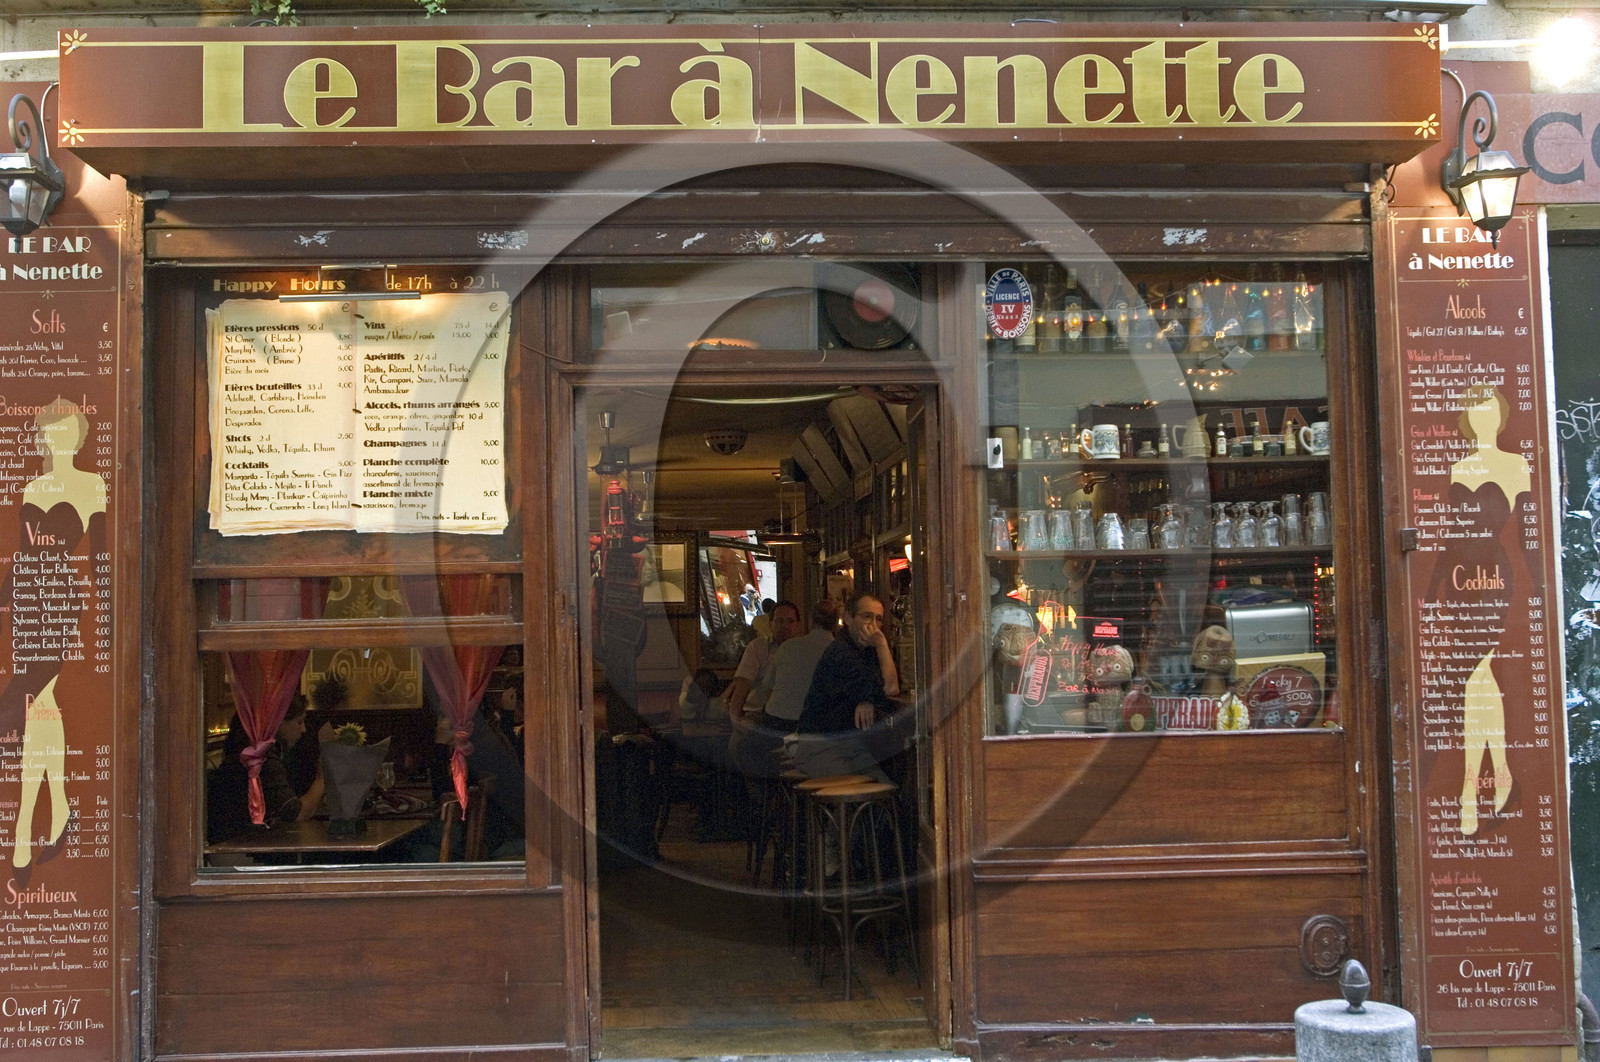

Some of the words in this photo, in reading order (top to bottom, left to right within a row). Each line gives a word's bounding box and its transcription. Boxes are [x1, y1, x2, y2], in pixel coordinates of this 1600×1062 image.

[202, 41, 358, 129] Le
[396, 40, 641, 129] Bar
[670, 41, 755, 128] à
[795, 40, 1306, 125] Nenette
[1523, 112, 1600, 184] C
[1422, 228, 1450, 243] LE
[1455, 228, 1501, 243] BAR
[8, 237, 37, 253] LE
[43, 236, 92, 253] BAR
[1409, 253, 1423, 270] à
[1428, 252, 1514, 270] Nenette
[13, 263, 103, 280] Nenette
[214, 279, 276, 292] Happy
[290, 278, 345, 290] Hours
[387, 274, 402, 290] de
[407, 274, 431, 290] 17h
[450, 278, 457, 289] à
[464, 276, 485, 288] 22
[492, 274, 499, 288] h
[986, 274, 1001, 297] VILLE
[1012, 273, 1029, 296] PARIS
[1001, 305, 1015, 313] IV
[1445, 294, 1486, 319] Alcools
[30, 311, 65, 334] Softs
[986, 305, 998, 327] DEBIT
[1003, 305, 1030, 337] BOISSONS
[225, 325, 254, 333] Bières
[256, 324, 299, 333] pressions
[392, 331, 411, 340] blancs
[225, 345, 255, 354] Murphy's
[225, 355, 256, 364] Guinness
[364, 353, 405, 361] Apéritifs
[225, 366, 241, 374] Bière
[364, 364, 386, 374] Pastis,
[389, 364, 414, 373] Ricard,
[417, 364, 446, 373] Martini,
[449, 364, 470, 373] Porto,
[364, 375, 377, 384] Kir,
[380, 374, 413, 385] Campari,
[439, 375, 468, 383] Marsala
[256, 383, 301, 391] bouteilles
[364, 385, 409, 394] Ambassadeur
[260, 393, 294, 401] Carlsberg,
[0, 395, 46, 416] Boissons
[52, 394, 97, 415] chaudes
[268, 405, 295, 414] Corona,
[225, 418, 261, 427] Desperados
[365, 423, 385, 431] Vodka
[425, 422, 449, 432] Téquila
[452, 422, 464, 431] Paf
[225, 445, 253, 454] Whisky,
[257, 445, 280, 453] Vodka,
[284, 444, 310, 454] Téquila,
[314, 443, 335, 452] Rhum
[364, 440, 427, 448] Champagnes
[405, 459, 449, 467] complète
[225, 472, 257, 481] Margarita
[266, 471, 289, 480] Téquila
[323, 469, 336, 477] Gin
[340, 469, 352, 477] Fizz
[363, 468, 402, 477] charcuterie,
[243, 482, 267, 490] Colada
[275, 482, 296, 490] Mojito
[313, 480, 332, 488] Punch
[414, 479, 444, 488] fromages
[225, 493, 248, 502] Bloody
[250, 493, 269, 501] Mary
[225, 503, 262, 512] Screwdriver
[313, 501, 329, 510] Long
[400, 501, 427, 509] fromage
[26, 521, 55, 546] Vins
[13, 552, 38, 562] Château
[64, 551, 88, 561] Sancerre
[96, 553, 110, 561] 4,00
[13, 564, 38, 575] Château
[40, 564, 53, 574] Tour
[55, 563, 78, 573] Bellevue
[13, 577, 31, 587] Lussac
[1452, 565, 1504, 590] Cocktails
[13, 589, 37, 601] Gamay,
[40, 588, 66, 599] Bordeaux
[13, 601, 40, 612] Sancerre,
[43, 600, 69, 611] Muscadet
[13, 614, 39, 626] Sylvaner,
[42, 613, 78, 625] Chardonnay
[13, 626, 38, 637] Bergerac
[40, 626, 61, 636] château
[13, 638, 40, 649] Corbières
[62, 650, 84, 661] Chablis
[1286, 692, 1313, 702] SODA
[5, 878, 77, 909] Spiritueux
[50, 935, 67, 944] Grand
[69, 935, 90, 944] Marnier
[1459, 959, 1501, 978] Ouvert
[1506, 959, 1533, 981] 7j/7
[1437, 984, 1448, 994] 26
[1451, 983, 1459, 993] bis
[1475, 982, 1482, 992] de
[1485, 981, 1505, 994] Lappe
[1513, 982, 1535, 992] 75011
[1538, 981, 1556, 991] Paris
[2, 997, 47, 1016] Ouvert
[53, 995, 81, 1019] 7j/7
[1476, 998, 1484, 1007] 01
[1487, 998, 1498, 1007] 48
[1501, 998, 1512, 1007] 07
[1514, 998, 1526, 1006] 08
[1529, 997, 1537, 1006] 18
[29, 1020, 49, 1033] Lappe
[59, 1020, 82, 1030] 75011
[86, 1018, 104, 1029] Paris
